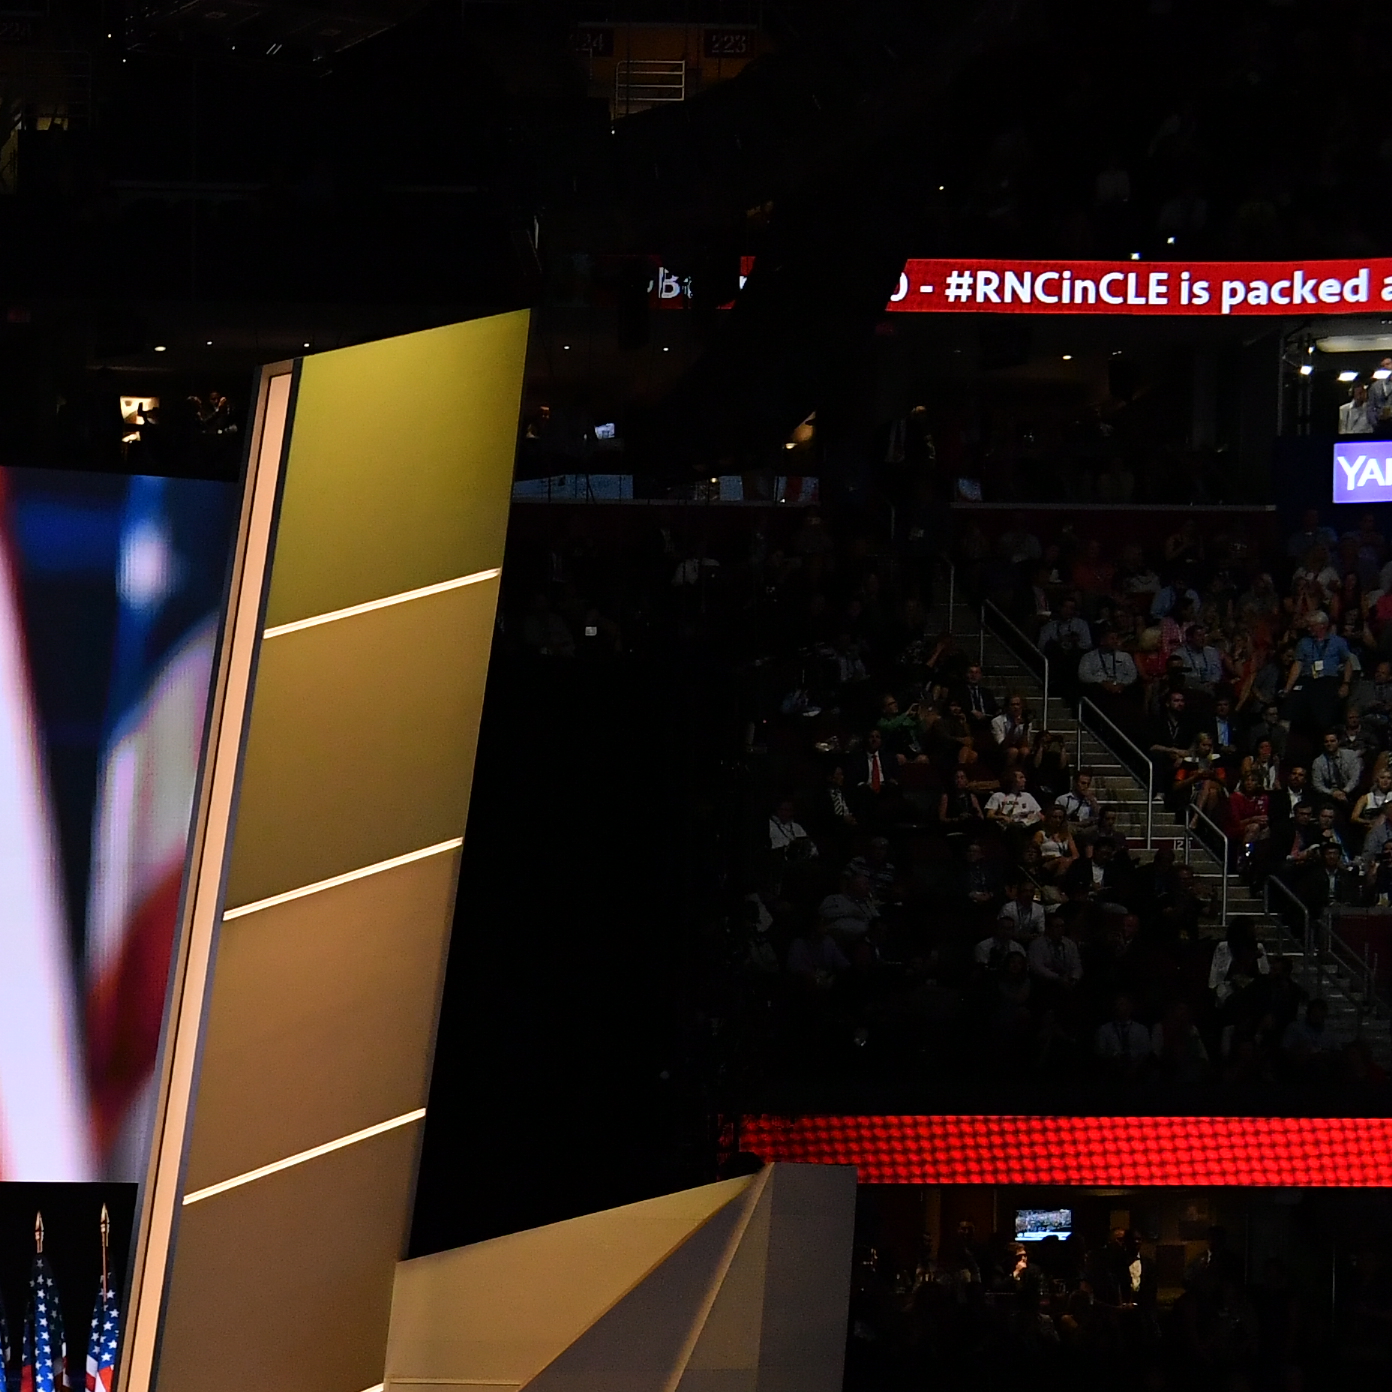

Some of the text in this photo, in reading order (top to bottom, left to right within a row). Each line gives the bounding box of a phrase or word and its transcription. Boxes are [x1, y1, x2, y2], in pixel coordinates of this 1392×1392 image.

[944, 270, 1168, 306] #RNCinCLE
[1179, 271, 1210, 306] is
[1221, 269, 1370, 314] packed
